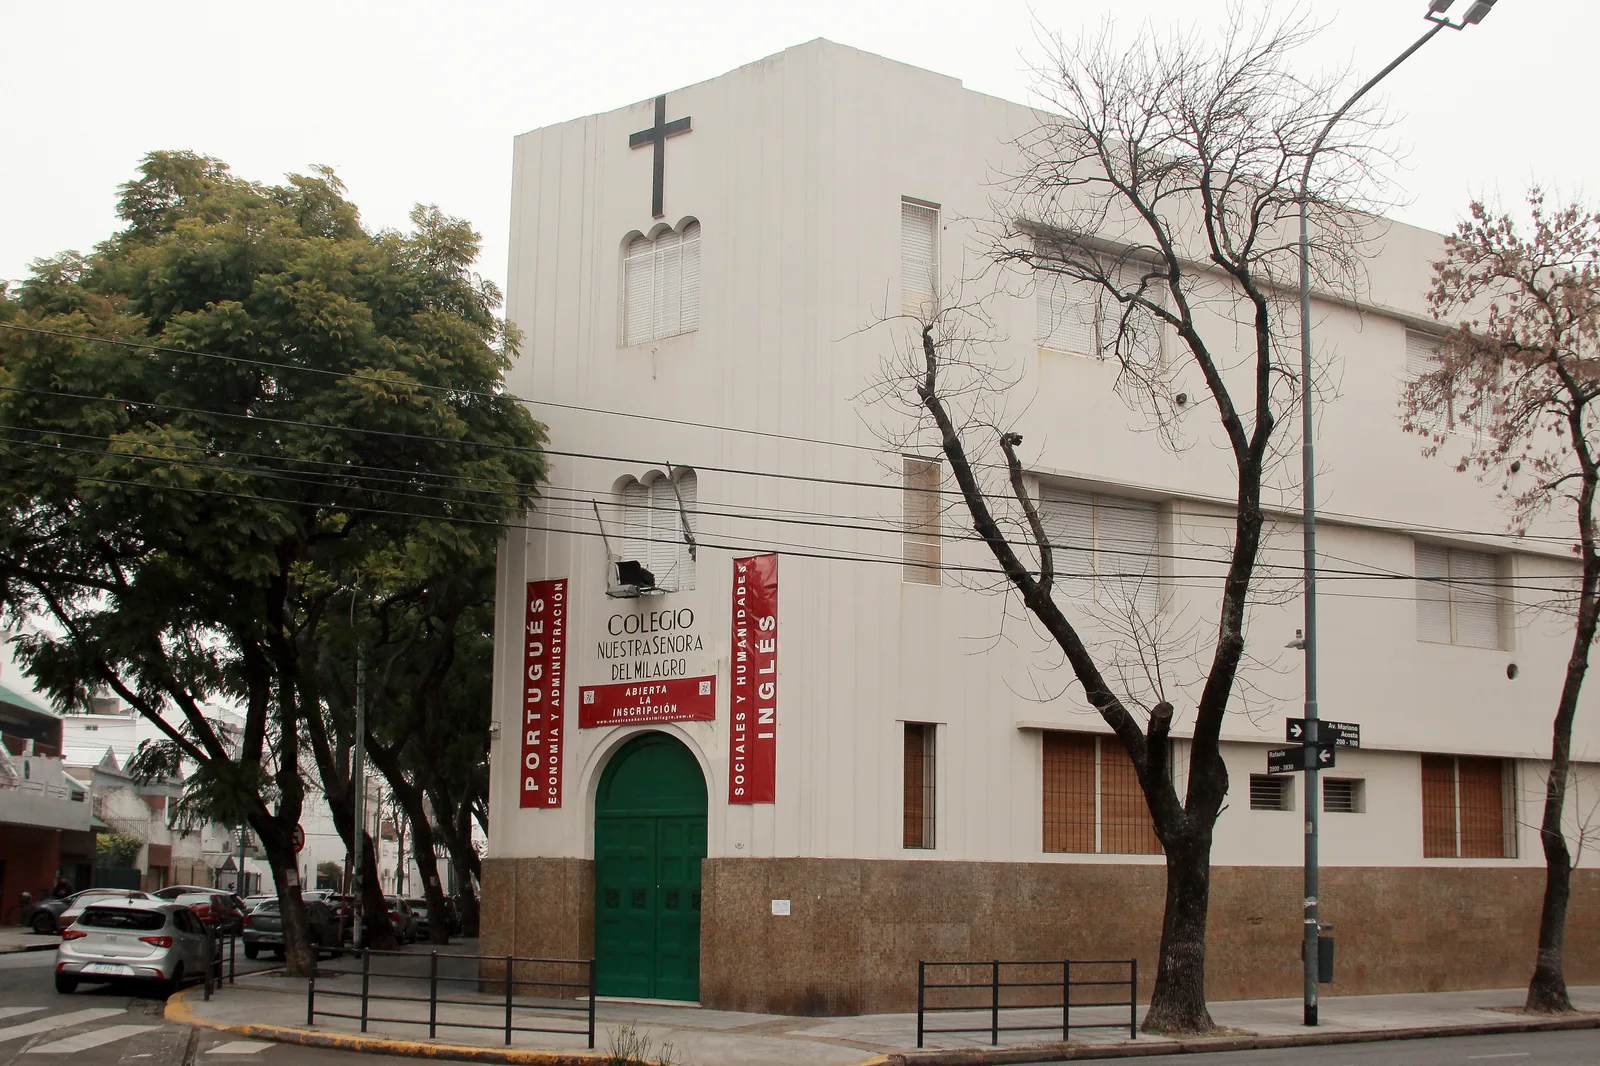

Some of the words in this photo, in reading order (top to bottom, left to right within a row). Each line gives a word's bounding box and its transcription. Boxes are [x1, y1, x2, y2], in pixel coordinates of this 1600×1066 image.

[608, 608, 694, 636] COLEGIO
[736, 565, 747, 685] HUMANIDADES
[551, 583, 563, 706] ADMINISTRACIÓN
[597, 638, 650, 660] NUESTRA
[652, 633, 704, 655] SEÑORA
[611, 663, 632, 681] DEL
[634, 658, 687, 679] MILAGRO
[754, 615, 776, 739] INGLÉS
[525, 598, 545, 791] PORTUGUÉS
[625, 685, 667, 697] ABIERTA
[639, 696, 651, 705] LA
[736, 695, 746, 703] Y
[551, 713, 559, 721] Y
[612, 703, 678, 717] INSCRIPCIÓN
[1337, 723, 1358, 731] Mariano
[548, 728, 559, 804] ECONOMÍA
[735, 712, 746, 796] SOCIALES
